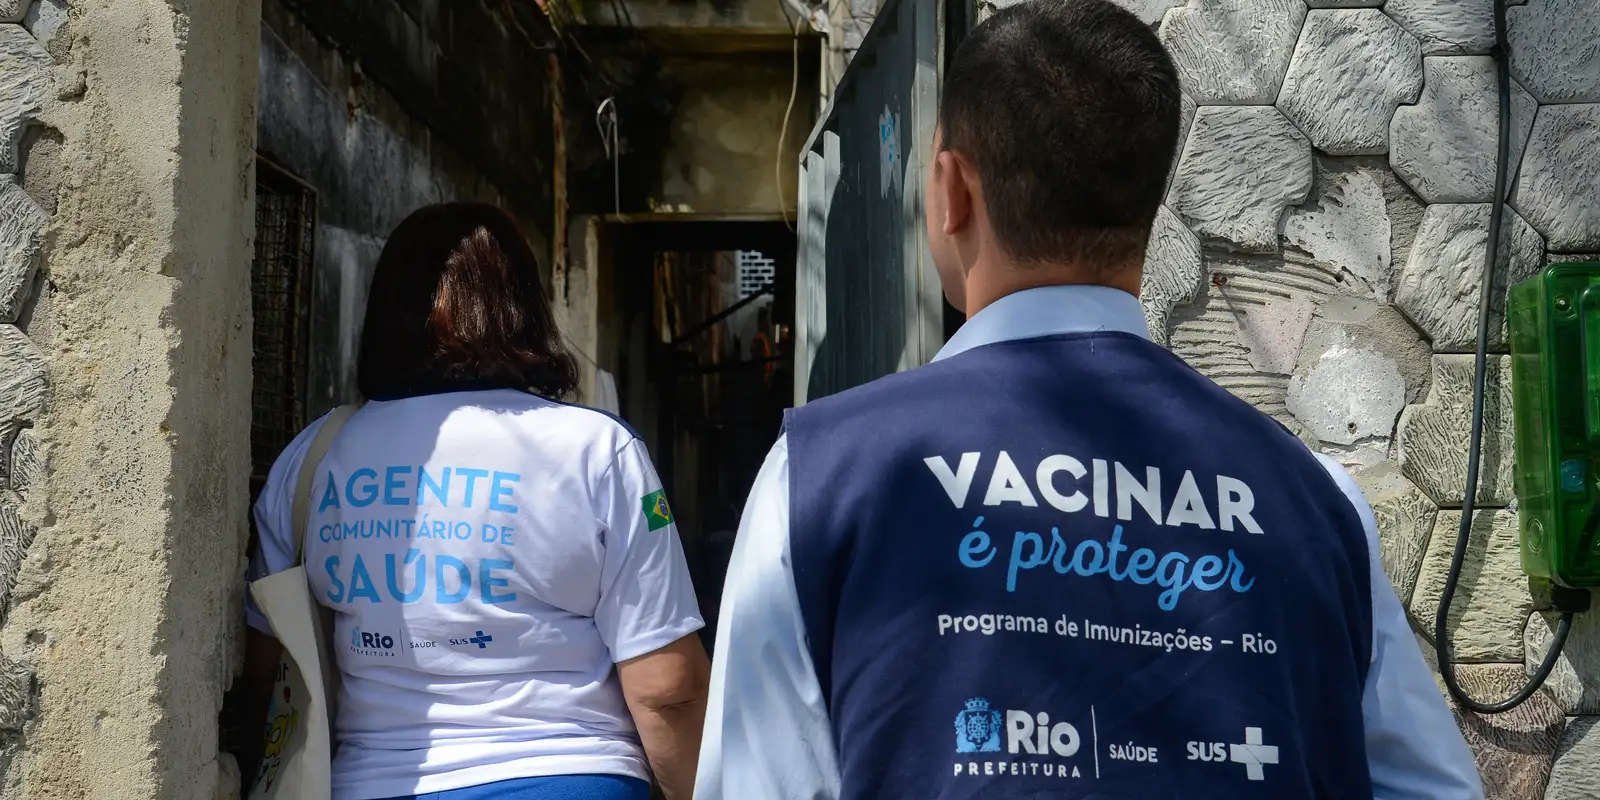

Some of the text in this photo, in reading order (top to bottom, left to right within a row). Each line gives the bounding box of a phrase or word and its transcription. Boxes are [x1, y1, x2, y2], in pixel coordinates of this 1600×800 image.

[317, 465, 521, 514] AGENTE
[923, 450, 1264, 534] VACINAR
[319, 513, 515, 546] COMUNITÁRIO DE
[324, 548, 516, 604] SAÚDE
[957, 515, 1256, 611] é proteger
[361, 632, 394, 649] Rio
[409, 640, 437, 649] SAÚDE
[449, 638, 469, 646] SUS
[937, 613, 1048, 636] Programa
[1055, 614, 1079, 637] de
[1084, 619, 1213, 653] Imunizações
[1242, 632, 1278, 655] Rio
[1006, 709, 1080, 756] Rio
[1109, 741, 1158, 763] SAÚDE
[1186, 741, 1227, 762] SUS
[953, 761, 1081, 778] PREFEITURA
